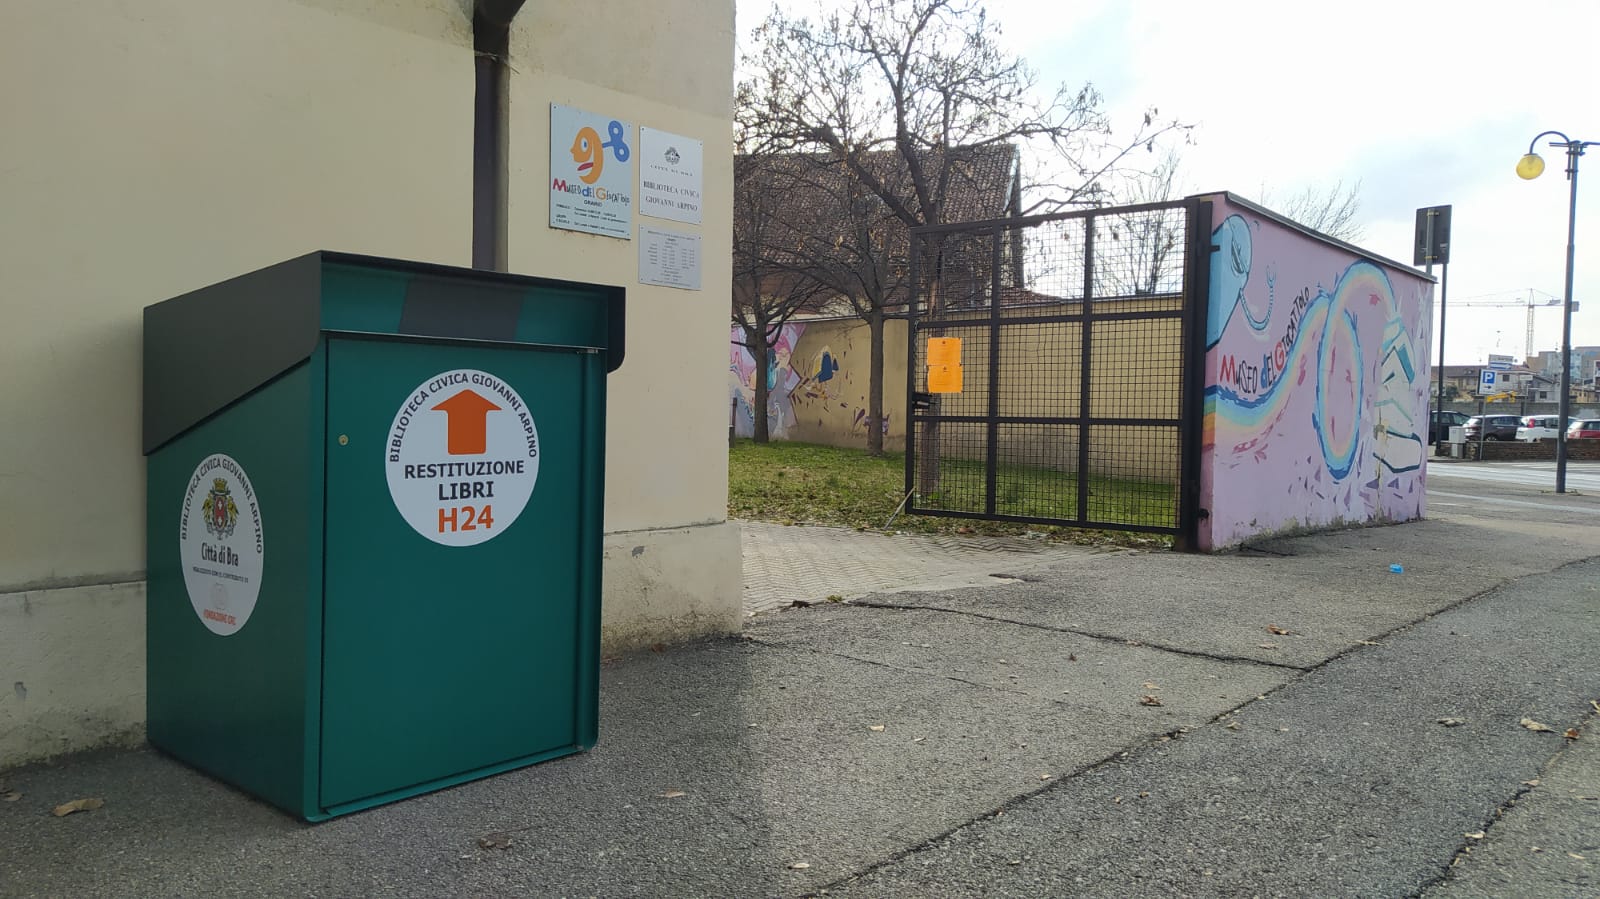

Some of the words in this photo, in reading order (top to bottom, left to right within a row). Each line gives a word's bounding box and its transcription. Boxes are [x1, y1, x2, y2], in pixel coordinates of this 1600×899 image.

[643, 180, 679, 195] BIBLIOTECA
[645, 195, 674, 207] GIOVANNI
[389, 390, 430, 463] BIBLIOTECA
[429, 373, 469, 394] CIVICA
[471, 373, 522, 412] GIOVANNI
[518, 412, 537, 458] ARPINO
[404, 460, 525, 479] RESTITUZIONE
[438, 481, 494, 501] LIBRI
[181, 474, 201, 540] BIBLIOTECA
[200, 457, 222, 477] CIVICA
[222, 458, 252, 501] GIOVANNI
[250, 501, 263, 554] ARPINO
[438, 505, 494, 533] H24
[201, 542, 217, 562] Città
[218, 546, 226, 564] di
[227, 550, 239, 567] Bra
